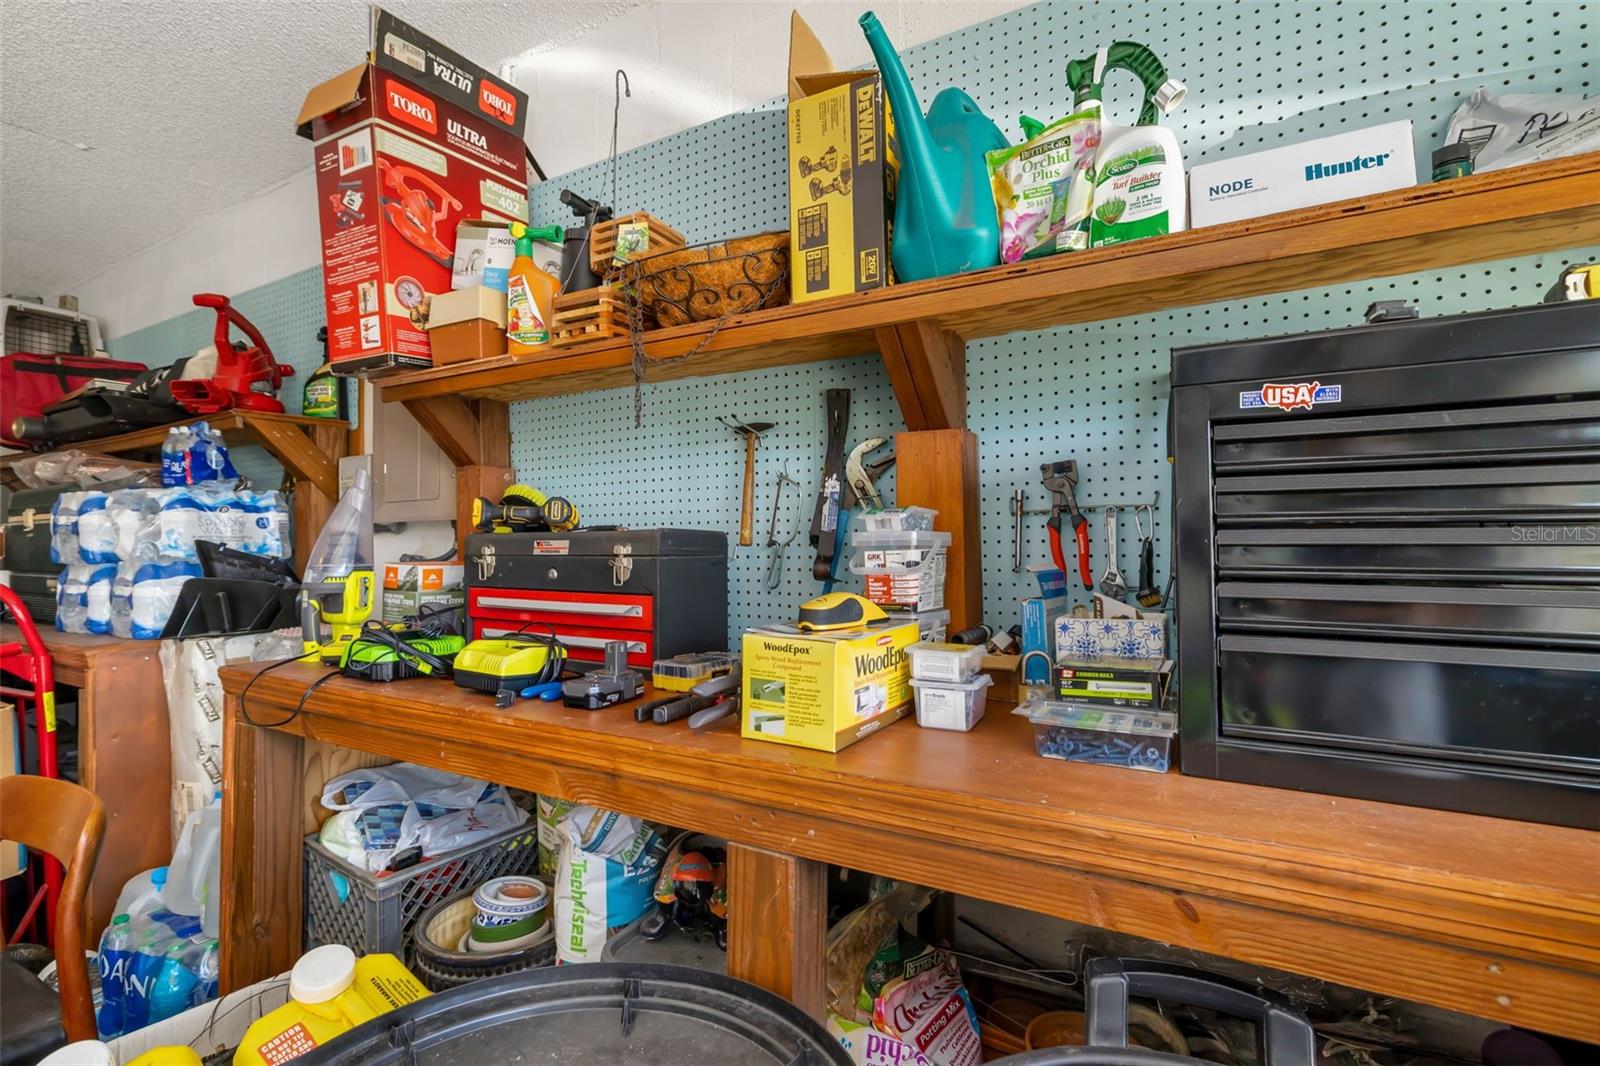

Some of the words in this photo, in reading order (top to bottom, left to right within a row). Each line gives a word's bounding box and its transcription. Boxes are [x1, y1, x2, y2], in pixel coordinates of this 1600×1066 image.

[433, 61, 472, 94] ULTRA
[390, 92, 434, 124] TORO
[482, 89, 513, 116] TORO
[447, 118, 488, 150] ULTRA
[1022, 148, 1070, 174] Orchid
[1110, 161, 1136, 174] Scotts
[1305, 154, 1390, 182] Hunter
[1032, 168, 1060, 182] Plus
[1112, 180, 1128, 190] Turf
[1130, 172, 1162, 186] Builder
[1209, 178, 1254, 196] NODE
[499, 197, 520, 214] 402
[1268, 386, 1311, 404] USA
[764, 642, 810, 656] WoodEpox
[773, 663, 802, 672] Compound
[788, 657, 822, 666] Replacement
[570, 860, 588, 954] Techniseal
[920, 1016, 947, 1046] Potting
[944, 1000, 960, 1018] Mix
[261, 1024, 302, 1053] CAUTION
[266, 1050, 278, 1060] DO
[278, 1040, 292, 1052] NOT
[292, 1032, 305, 1041] TIP
[272, 1046, 292, 1062] CAPS
[292, 1038, 306, 1049] ARE
[298, 1040, 314, 1052] AND
